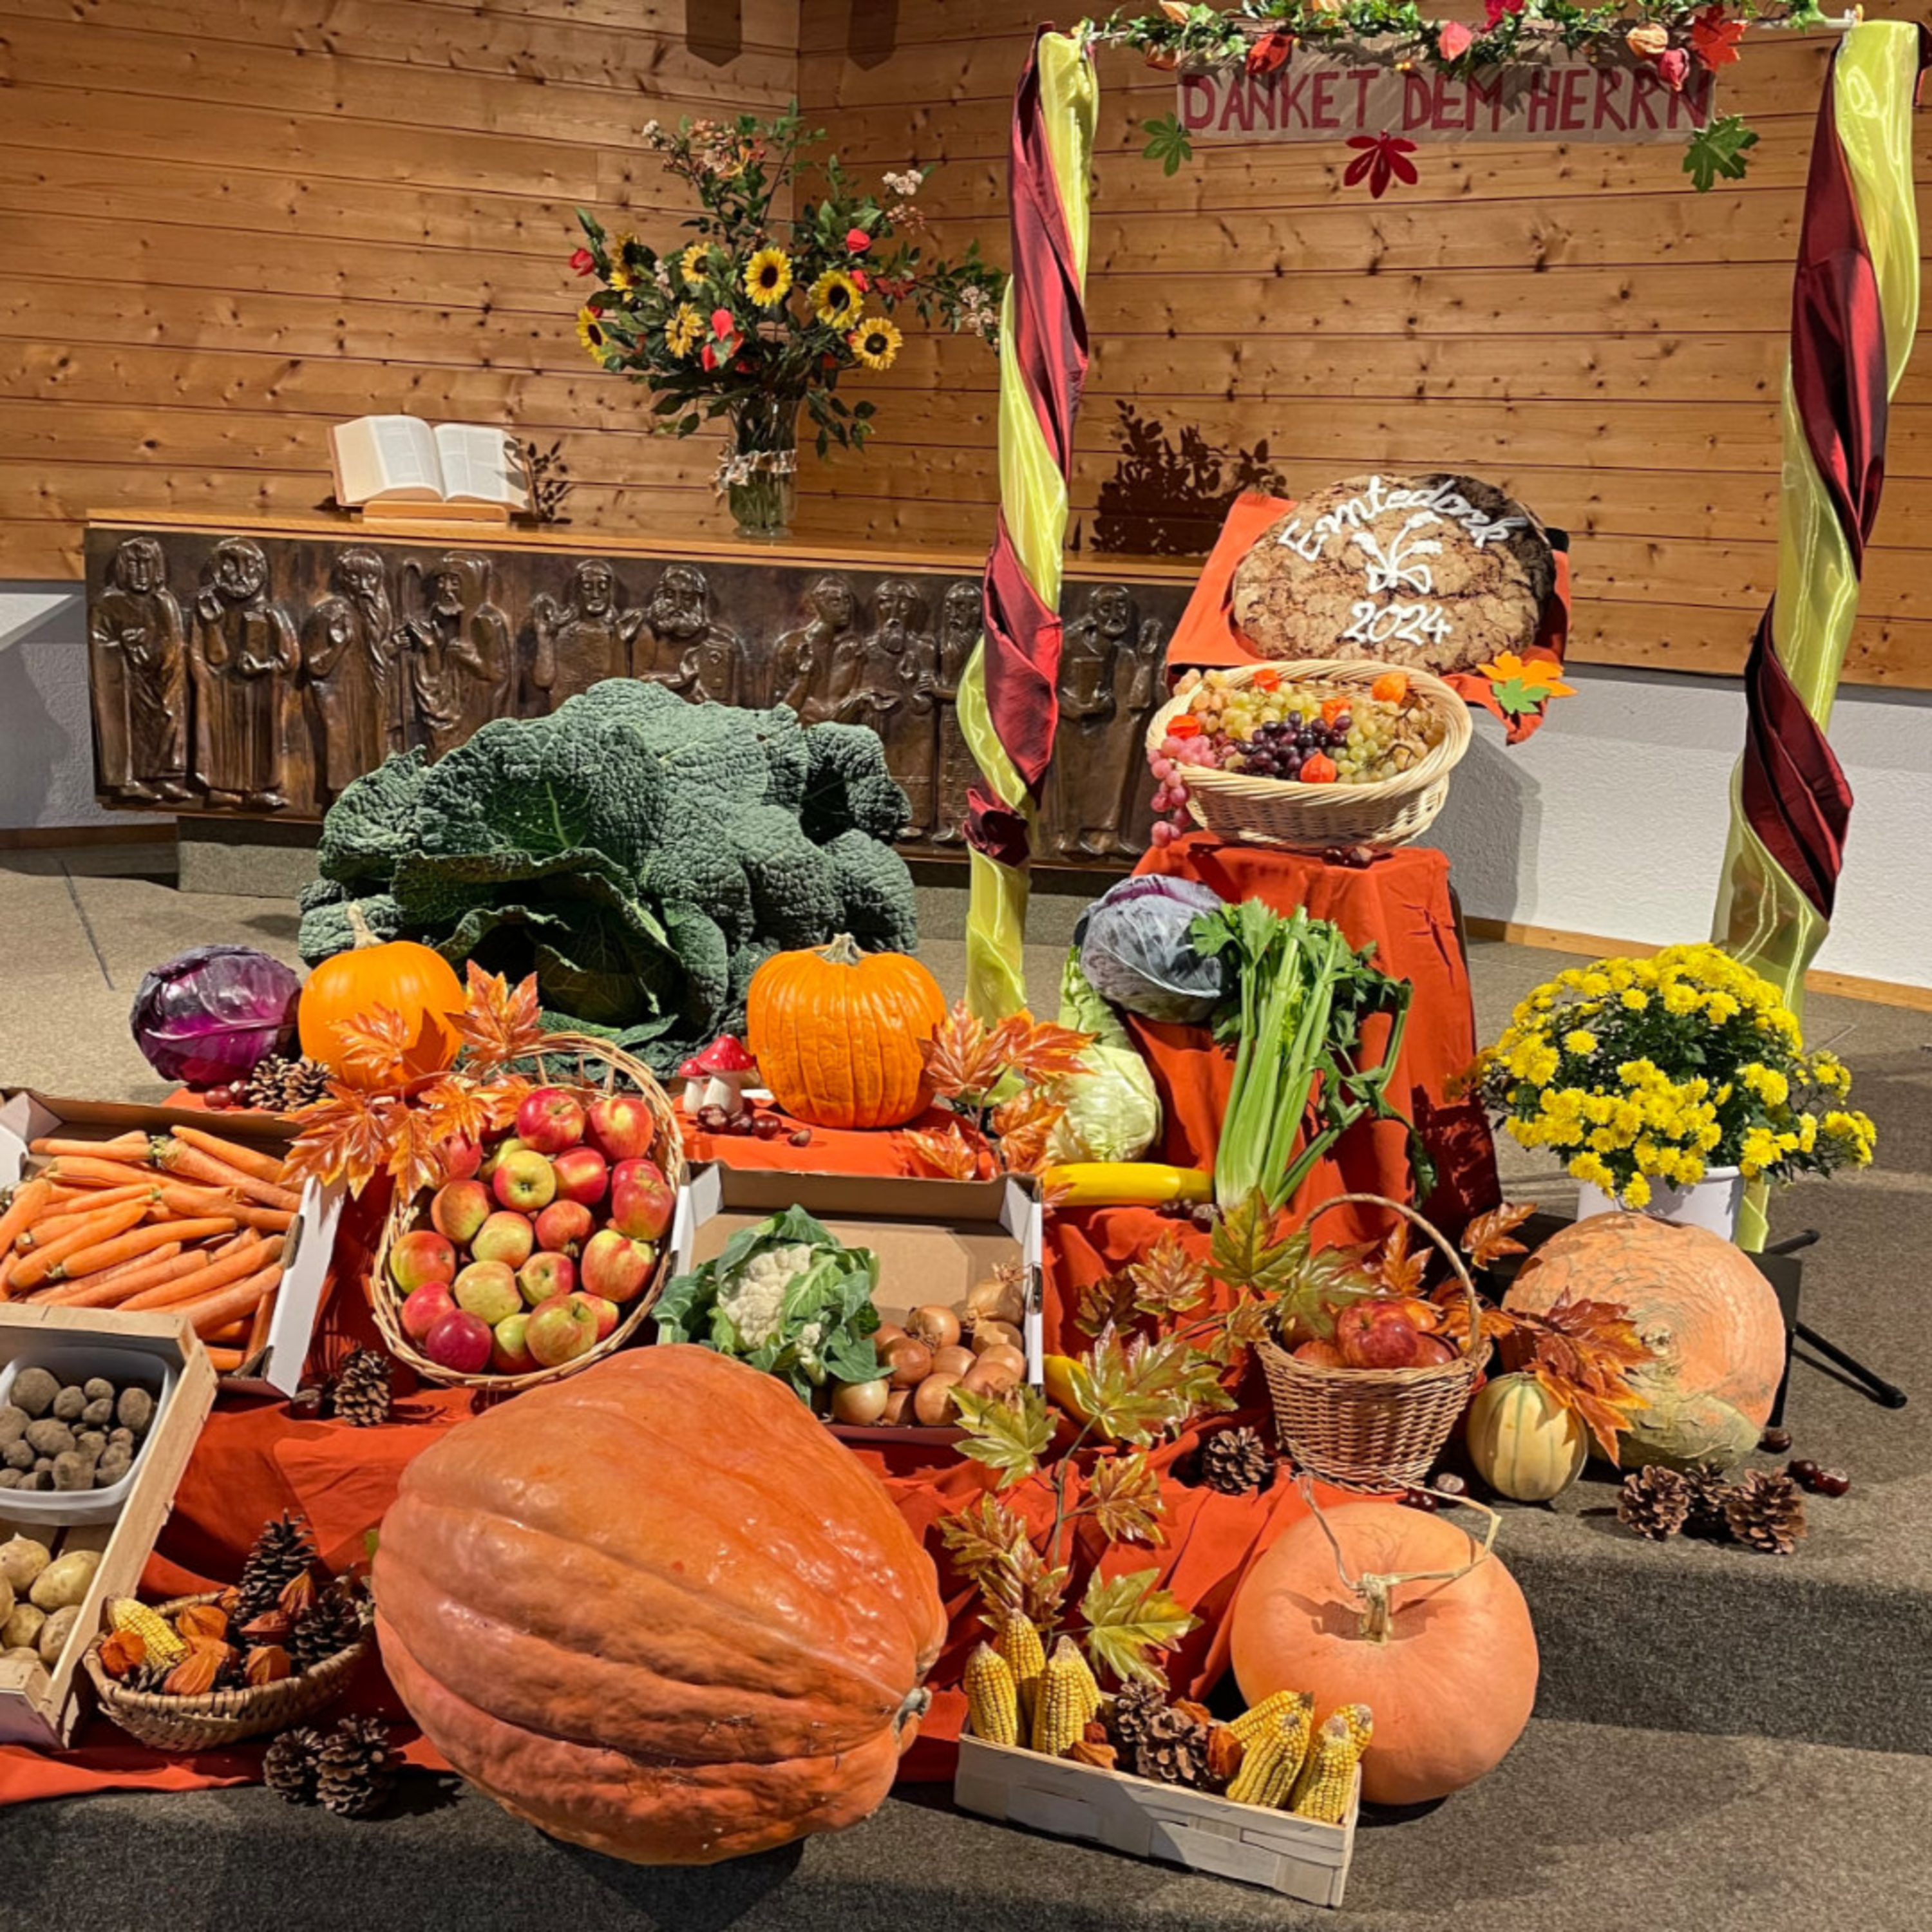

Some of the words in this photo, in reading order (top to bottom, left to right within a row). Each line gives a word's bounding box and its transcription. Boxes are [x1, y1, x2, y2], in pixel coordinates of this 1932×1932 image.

[1182, 69, 1379, 131] DANKET
[1402, 70, 1503, 130] DEM
[1527, 69, 1714, 131] HERRN
[1343, 601, 1452, 645] 2024
